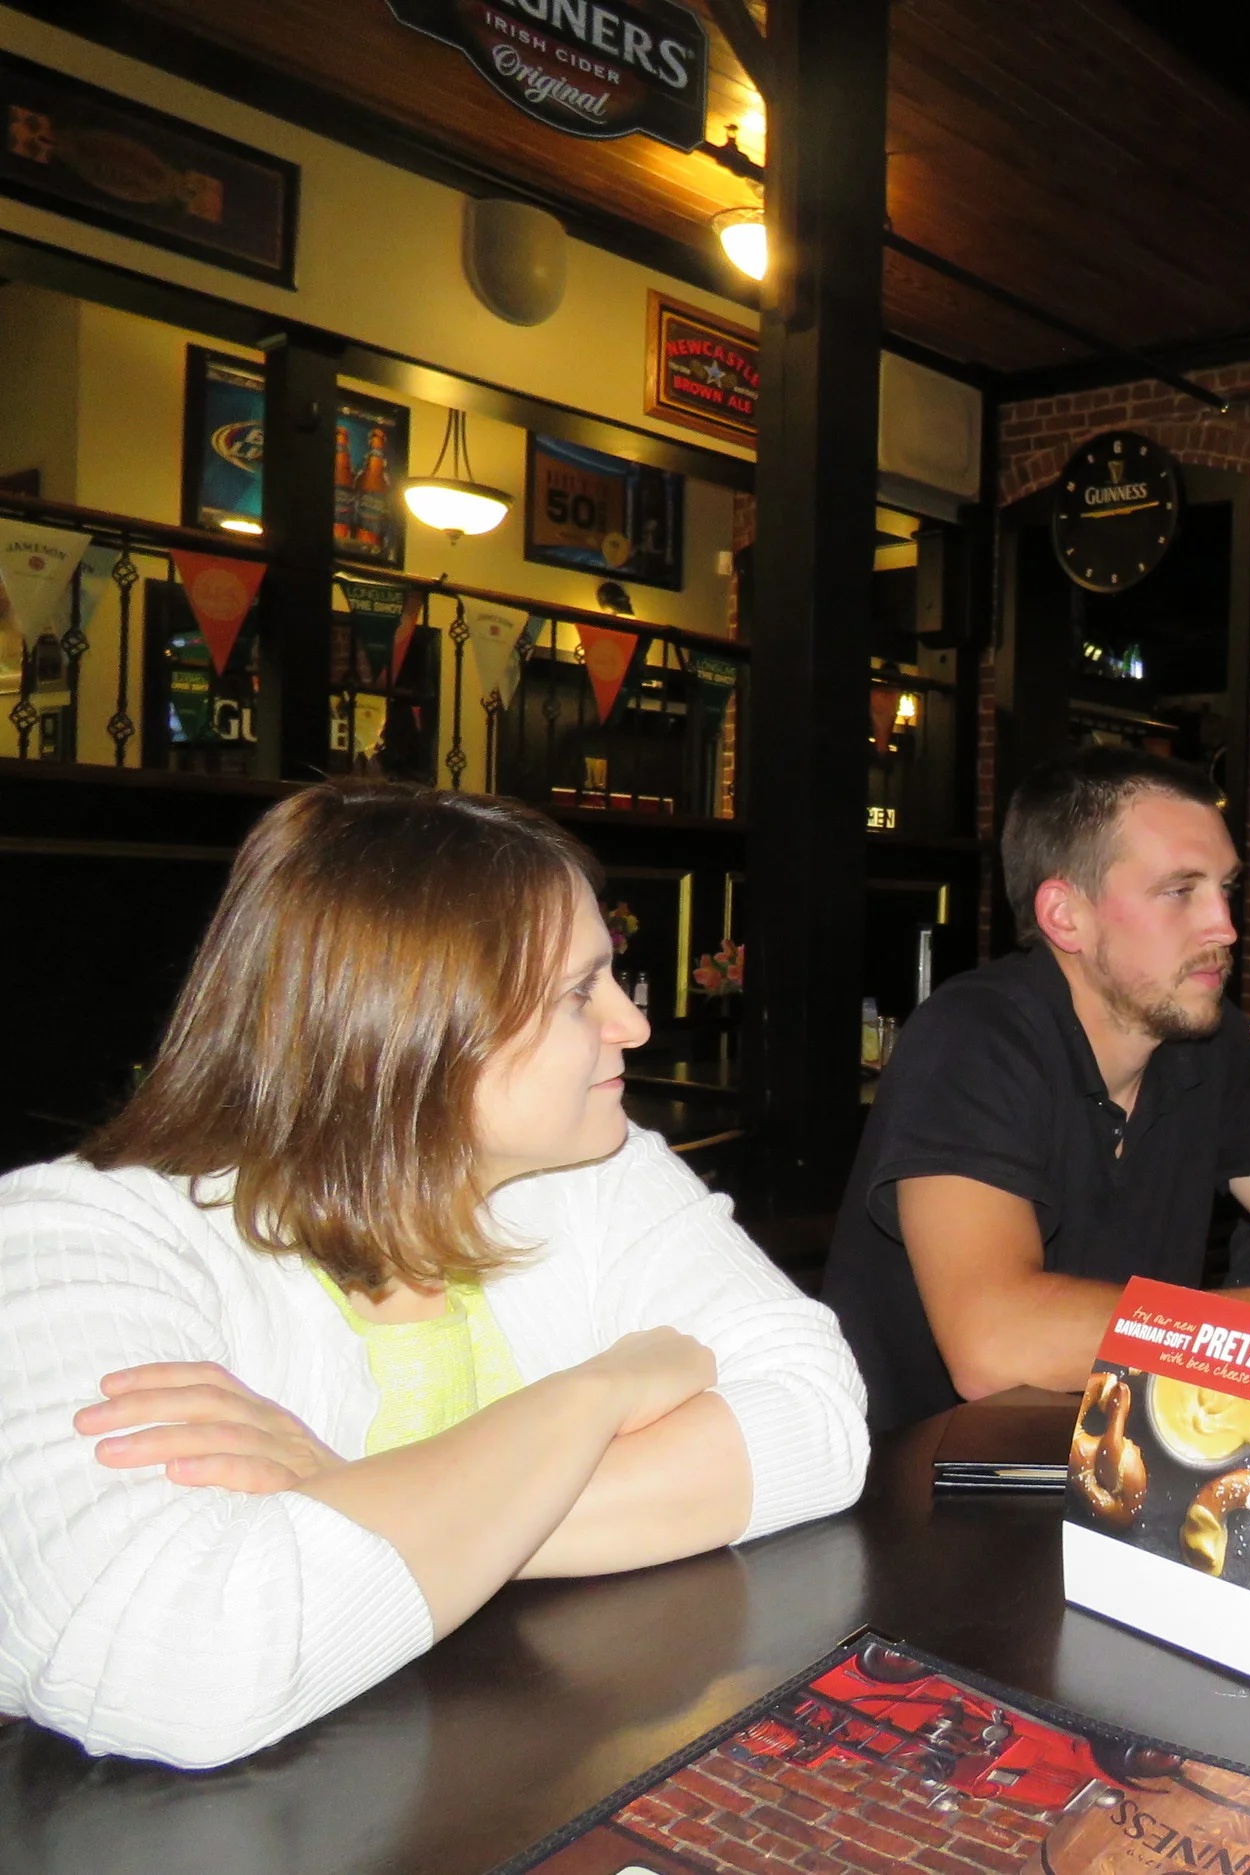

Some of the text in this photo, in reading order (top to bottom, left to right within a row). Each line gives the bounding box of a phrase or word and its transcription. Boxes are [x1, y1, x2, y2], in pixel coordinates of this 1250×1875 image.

[486, 11, 621, 85] IRISH CIDER
[493, 44, 610, 123] Original
[673, 375, 724, 403] BROWN
[728, 395, 751, 414] ALE
[1084, 483, 1147, 505] GUINNESS
[1114, 1318, 1165, 1344] BAVARIAN
[1163, 1331, 1193, 1351] SOFT
[1133, 1305, 1197, 1333] try our new
[1159, 1351, 1184, 1367] with
[1186, 1355, 1210, 1374] beer
[1213, 1363, 1250, 1385] cheese
